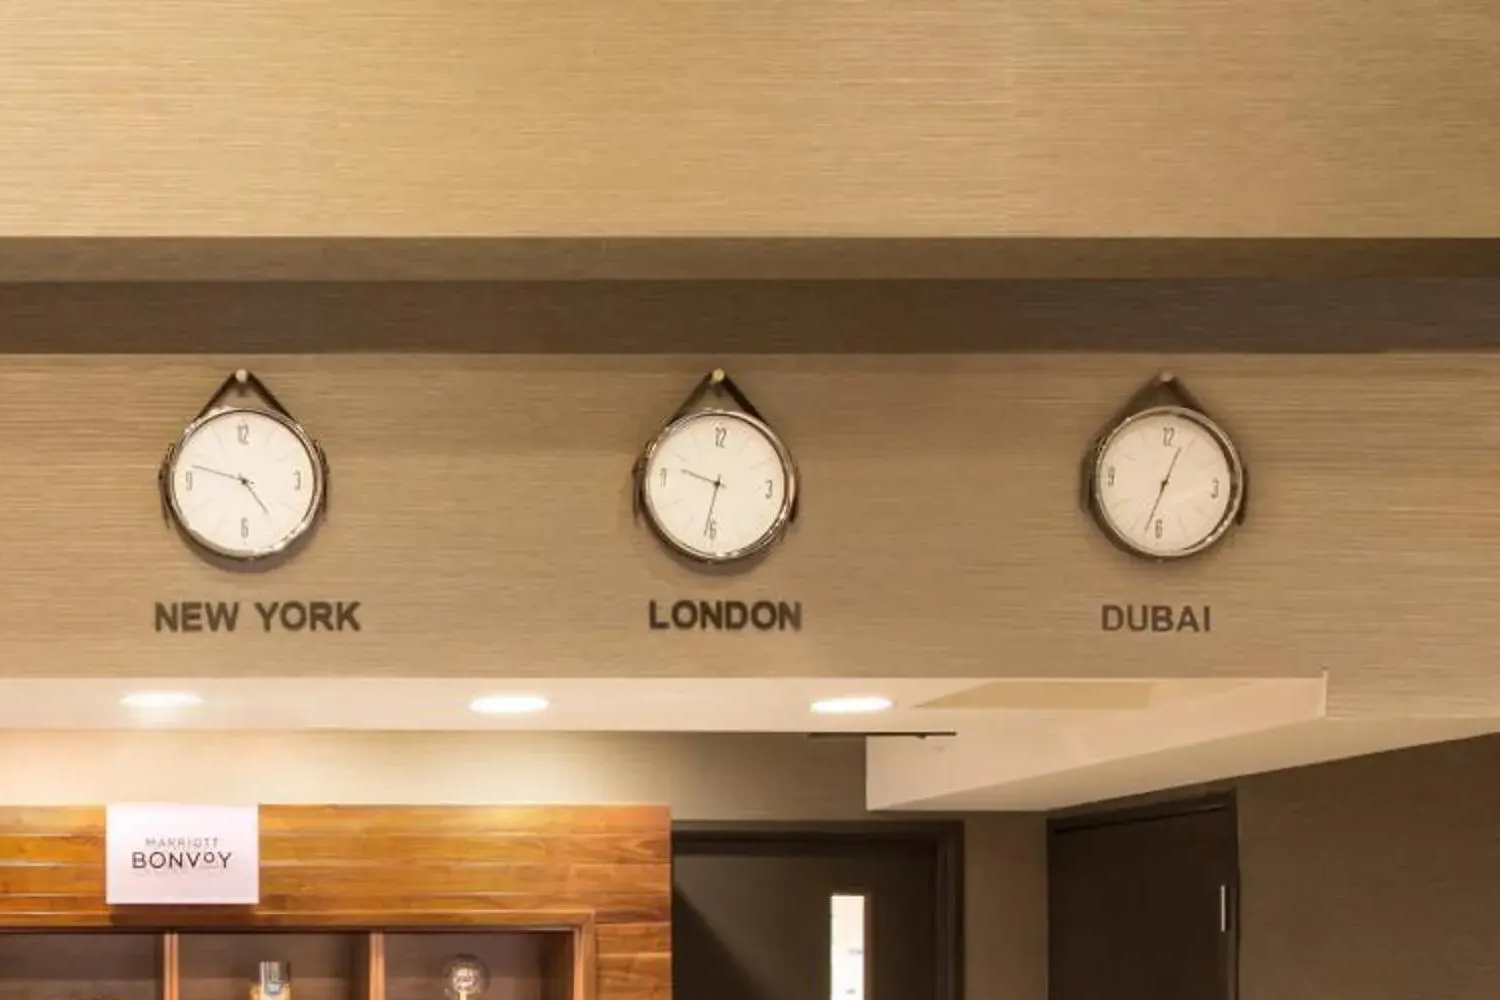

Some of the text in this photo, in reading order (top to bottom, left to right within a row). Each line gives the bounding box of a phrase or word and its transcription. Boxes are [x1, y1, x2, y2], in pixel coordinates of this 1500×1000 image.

[236, 424, 249, 445] 12
[715, 426, 727, 449] 12
[1162, 427, 1175, 447] 12
[154, 600, 361, 633] NEW YORK
[648, 599, 802, 632] LONDON
[1101, 604, 1211, 633] DUBAI
[144, 836, 219, 849] MARRIOTT
